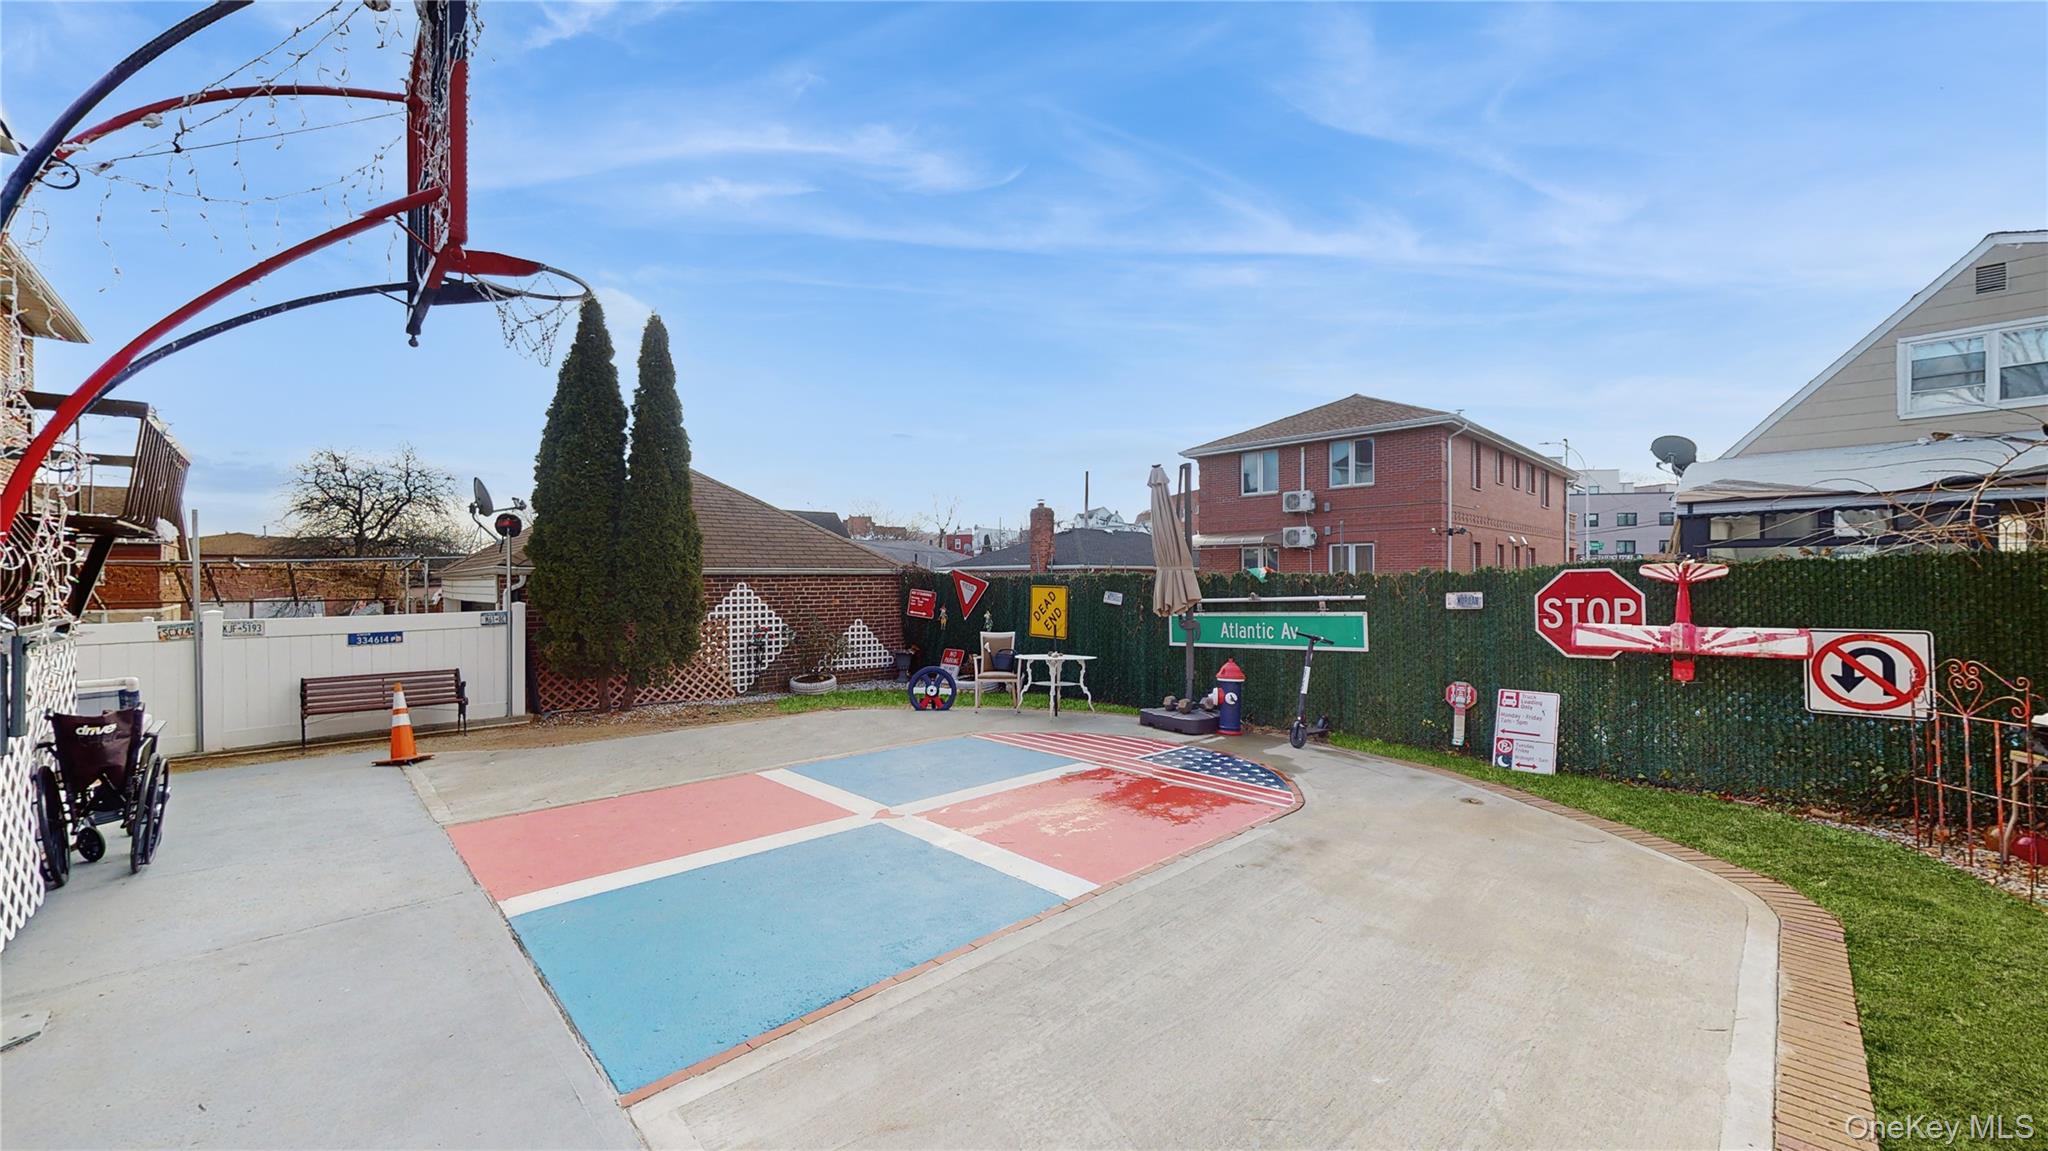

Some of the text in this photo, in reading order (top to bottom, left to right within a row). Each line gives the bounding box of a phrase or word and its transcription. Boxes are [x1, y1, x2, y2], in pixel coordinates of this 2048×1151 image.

[1033, 591, 1056, 622] DEAD
[1542, 598, 1637, 629] STOP
[1043, 607, 1062, 631] END
[1220, 622, 1299, 640] Atlantic Av
[1520, 699, 1543, 707] Loading
[75, 723, 118, 736] drive
